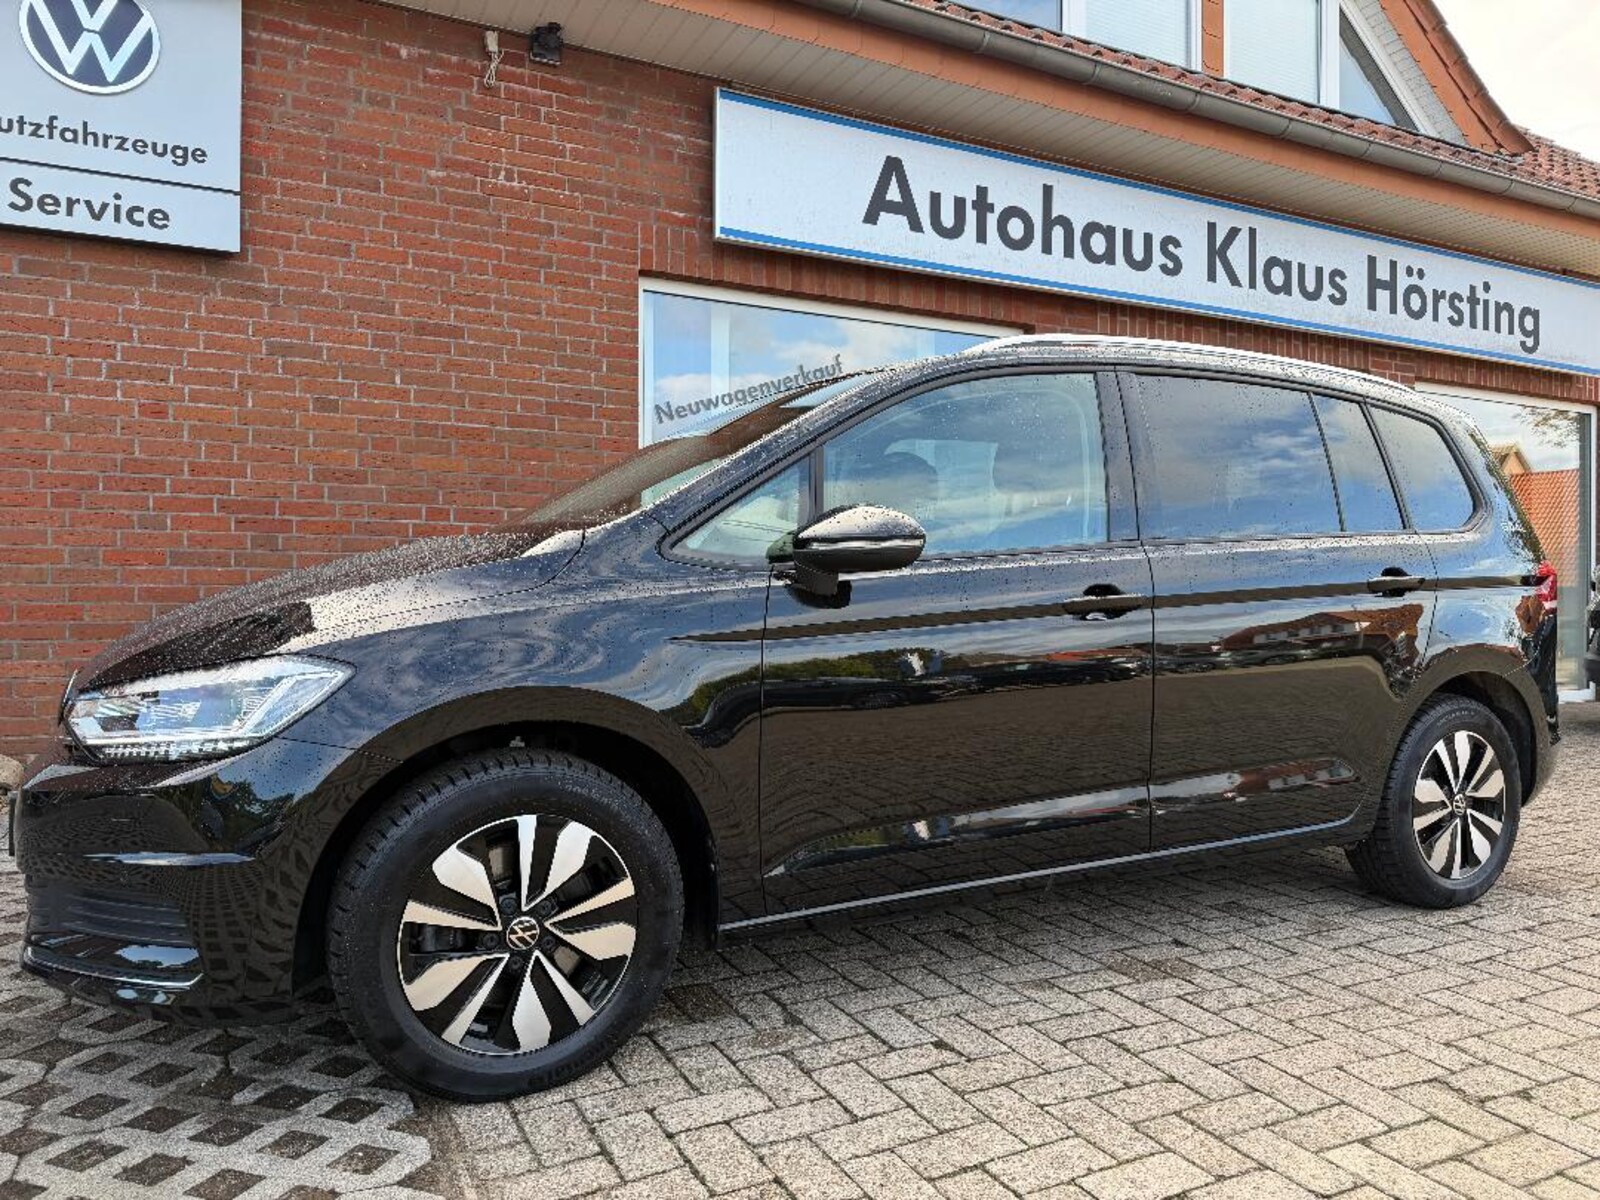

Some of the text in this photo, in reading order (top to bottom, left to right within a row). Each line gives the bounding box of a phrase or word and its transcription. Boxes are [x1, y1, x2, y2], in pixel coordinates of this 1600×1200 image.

[7, 177, 170, 230] Service
[862, 155, 1542, 354] Autohaus Klaus Hörsting
[655, 353, 844, 424] Neuwagenverkauf
